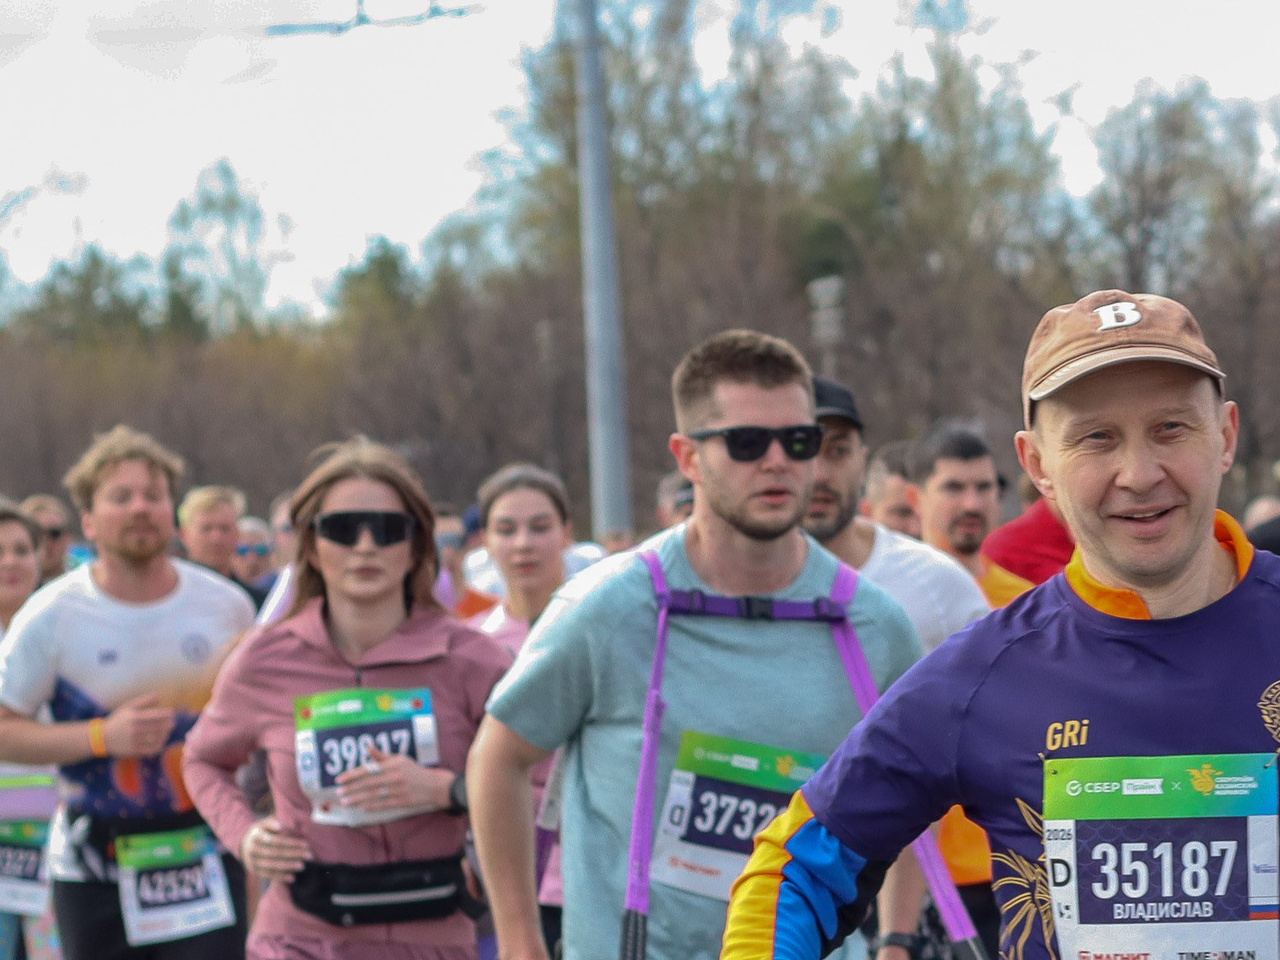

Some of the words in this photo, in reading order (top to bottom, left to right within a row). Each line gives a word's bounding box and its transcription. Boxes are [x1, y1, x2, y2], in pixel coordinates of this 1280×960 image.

[1093, 301, 1142, 331] B
[1046, 719, 1090, 751] GRi
[1084, 781, 1121, 793] СБЕР
[694, 790, 788, 842] 3732
[1050, 858, 1071, 887] D
[1091, 841, 1238, 899] 35187
[1113, 901, 1214, 920] ВЛАДИСЛАВ
